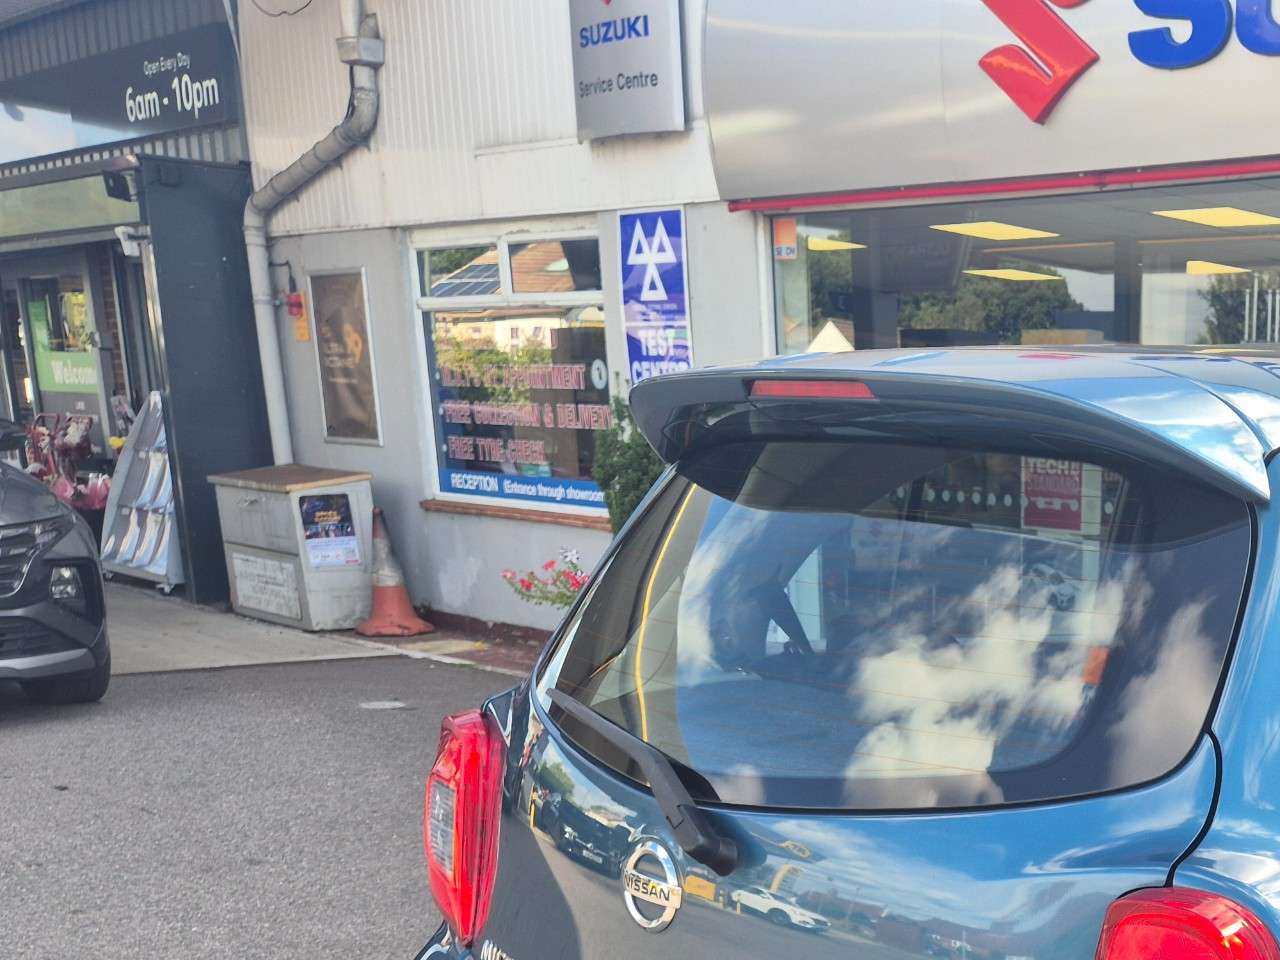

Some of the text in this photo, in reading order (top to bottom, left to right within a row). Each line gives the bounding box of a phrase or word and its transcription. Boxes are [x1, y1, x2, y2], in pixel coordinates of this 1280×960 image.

[579, 14, 650, 49] SUZUKI
[126, 86, 160, 122] 6am
[171, 74, 219, 119] 10pm
[578, 71, 658, 98] Service Centre
[637, 328, 675, 357] TEST
[1028, 457, 1070, 475] TECH
[450, 472, 499, 493] RECEPTION
[537, 483, 566, 501] through
[624, 870, 671, 902] NISSAN
